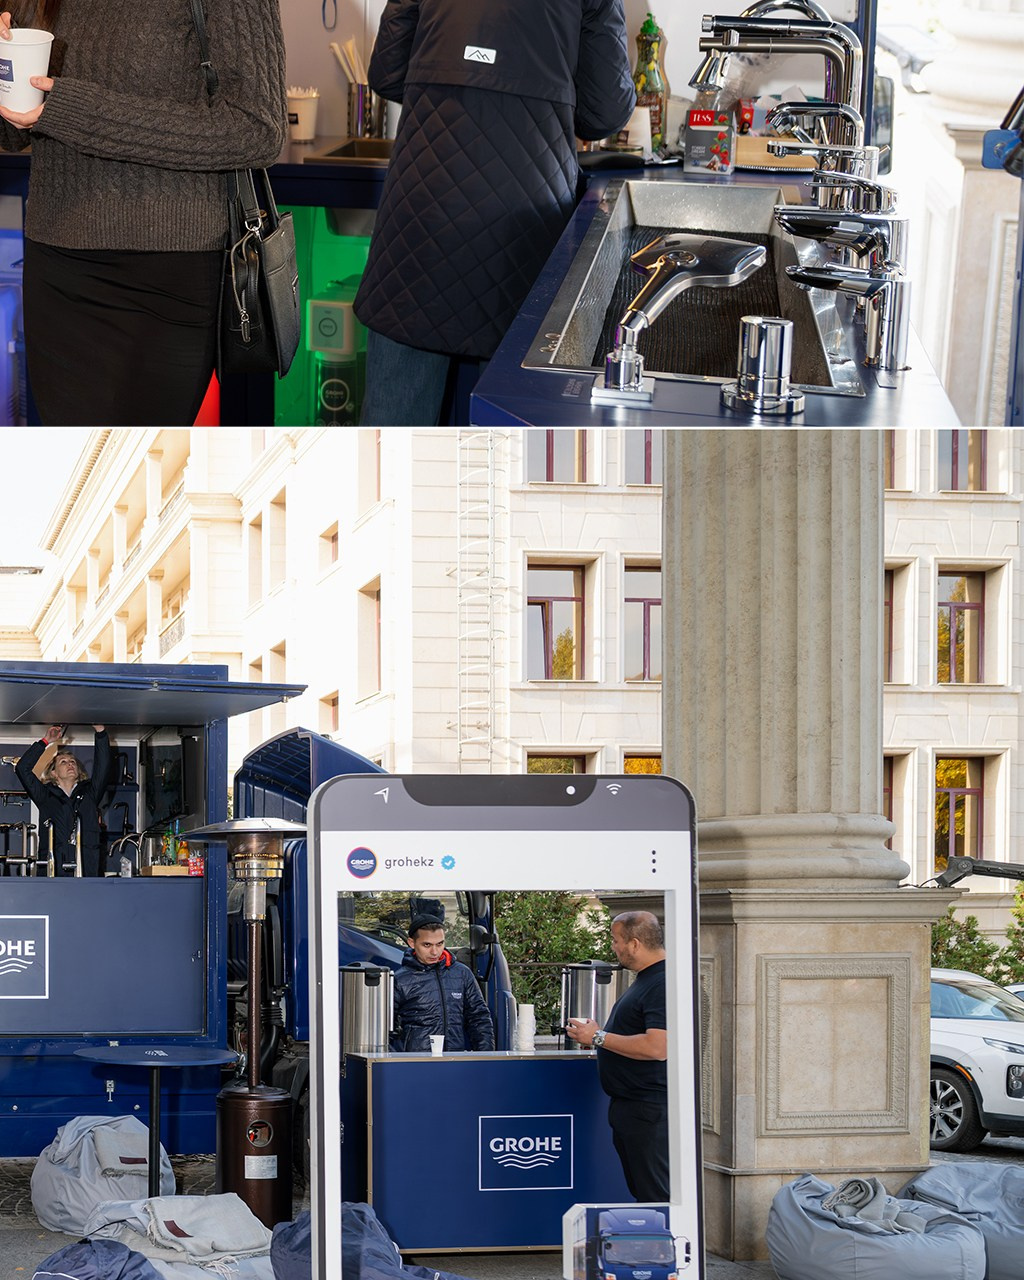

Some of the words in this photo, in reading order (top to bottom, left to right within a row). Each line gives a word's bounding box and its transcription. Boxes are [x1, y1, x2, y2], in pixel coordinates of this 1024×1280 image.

[693, 113, 712, 122] TESS
[384, 856, 434, 870] grohekz
[490, 1136, 562, 1152] GROHE
